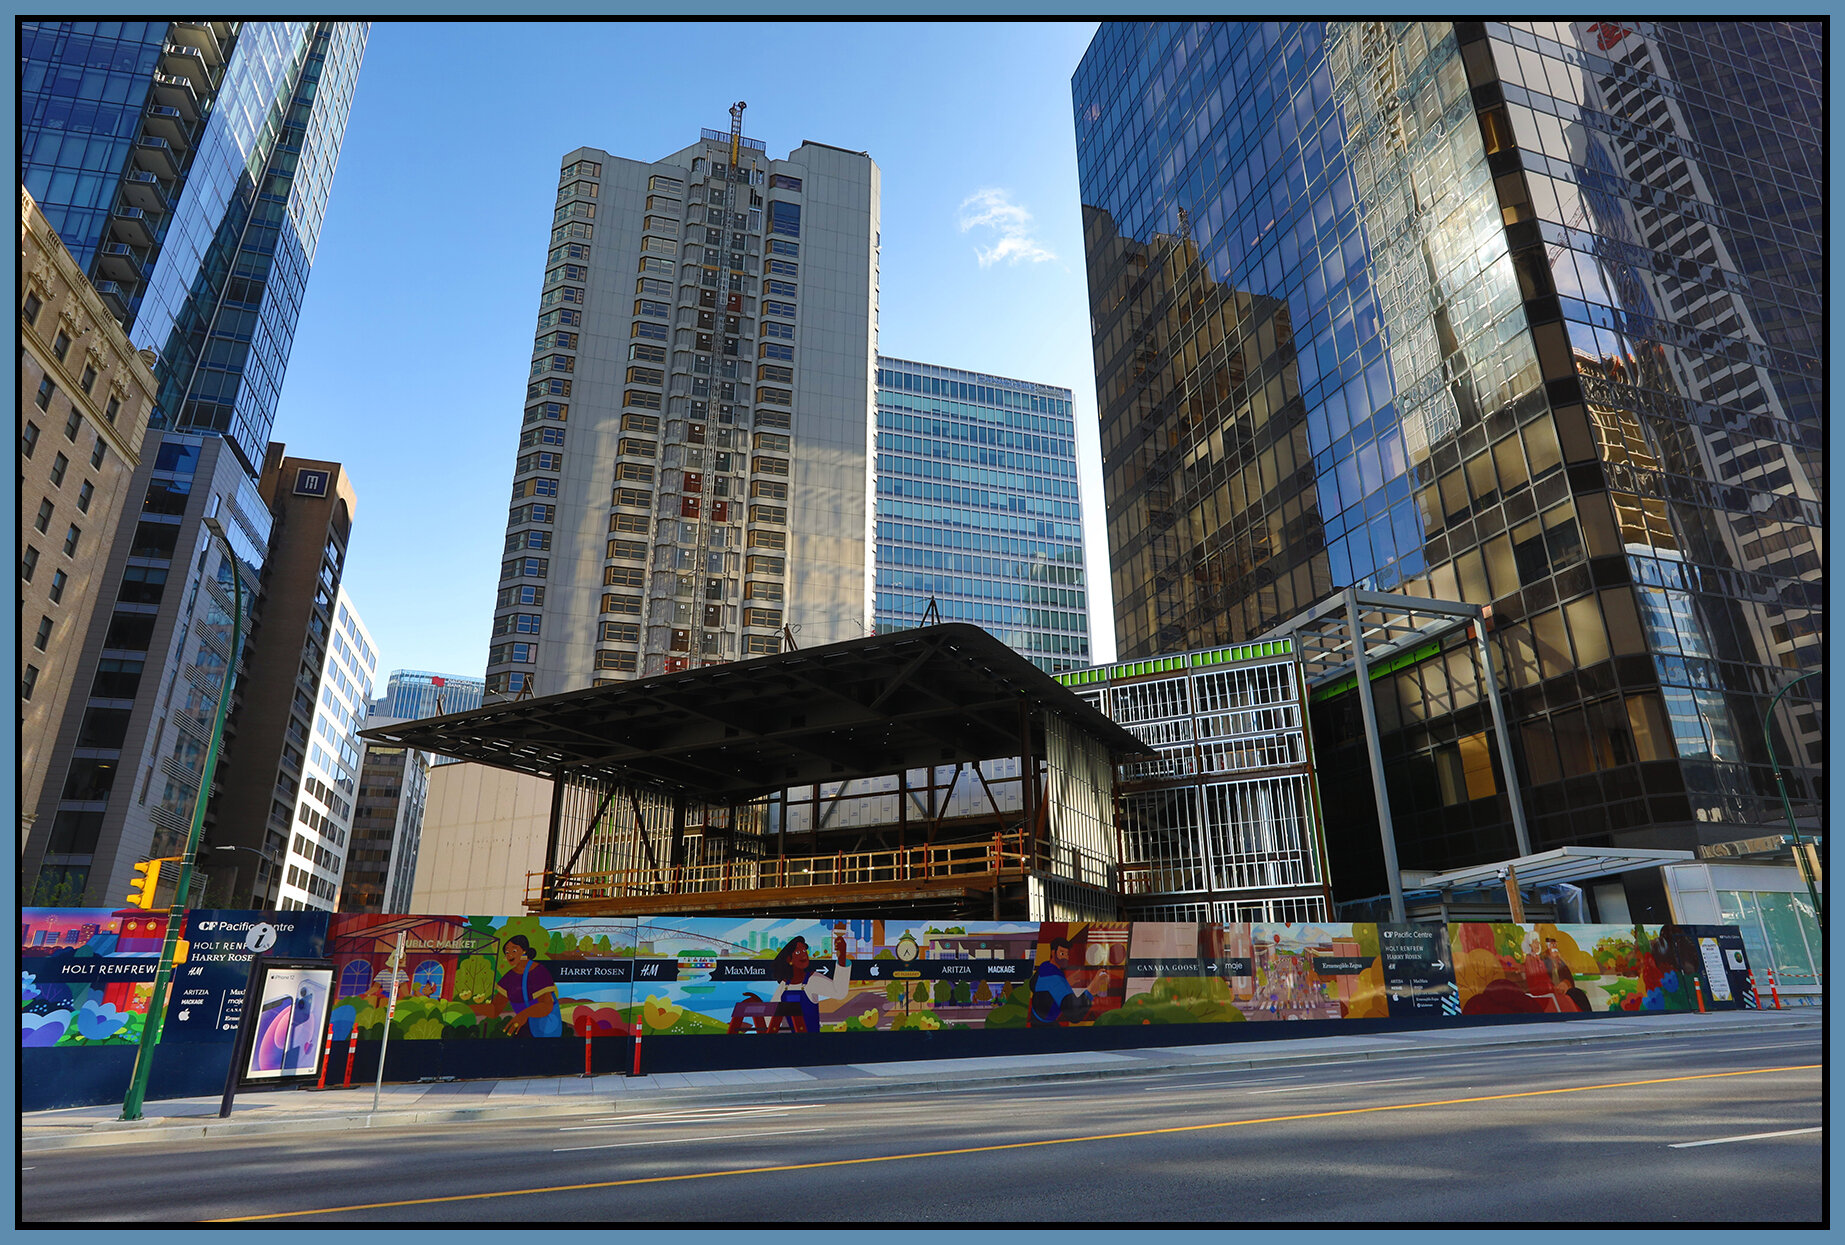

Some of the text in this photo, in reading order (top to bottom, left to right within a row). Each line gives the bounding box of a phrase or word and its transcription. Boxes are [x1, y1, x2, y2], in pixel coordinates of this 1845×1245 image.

[198, 921, 295, 932] CF Pacific ntre
[193, 942, 220, 950] HOLT
[405, 940, 476, 948] UBLIC MARKET
[191, 953, 255, 962] HARRY ROSE
[61, 964, 157, 975] HOLT RENFREW
[724, 965, 766, 975] MaxMara
[941, 966, 972, 974] ARITZIA
[987, 966, 1016, 974] MACKAGE
[1225, 962, 1243, 970] maje
[560, 966, 625, 976] HARRY ROSEN
